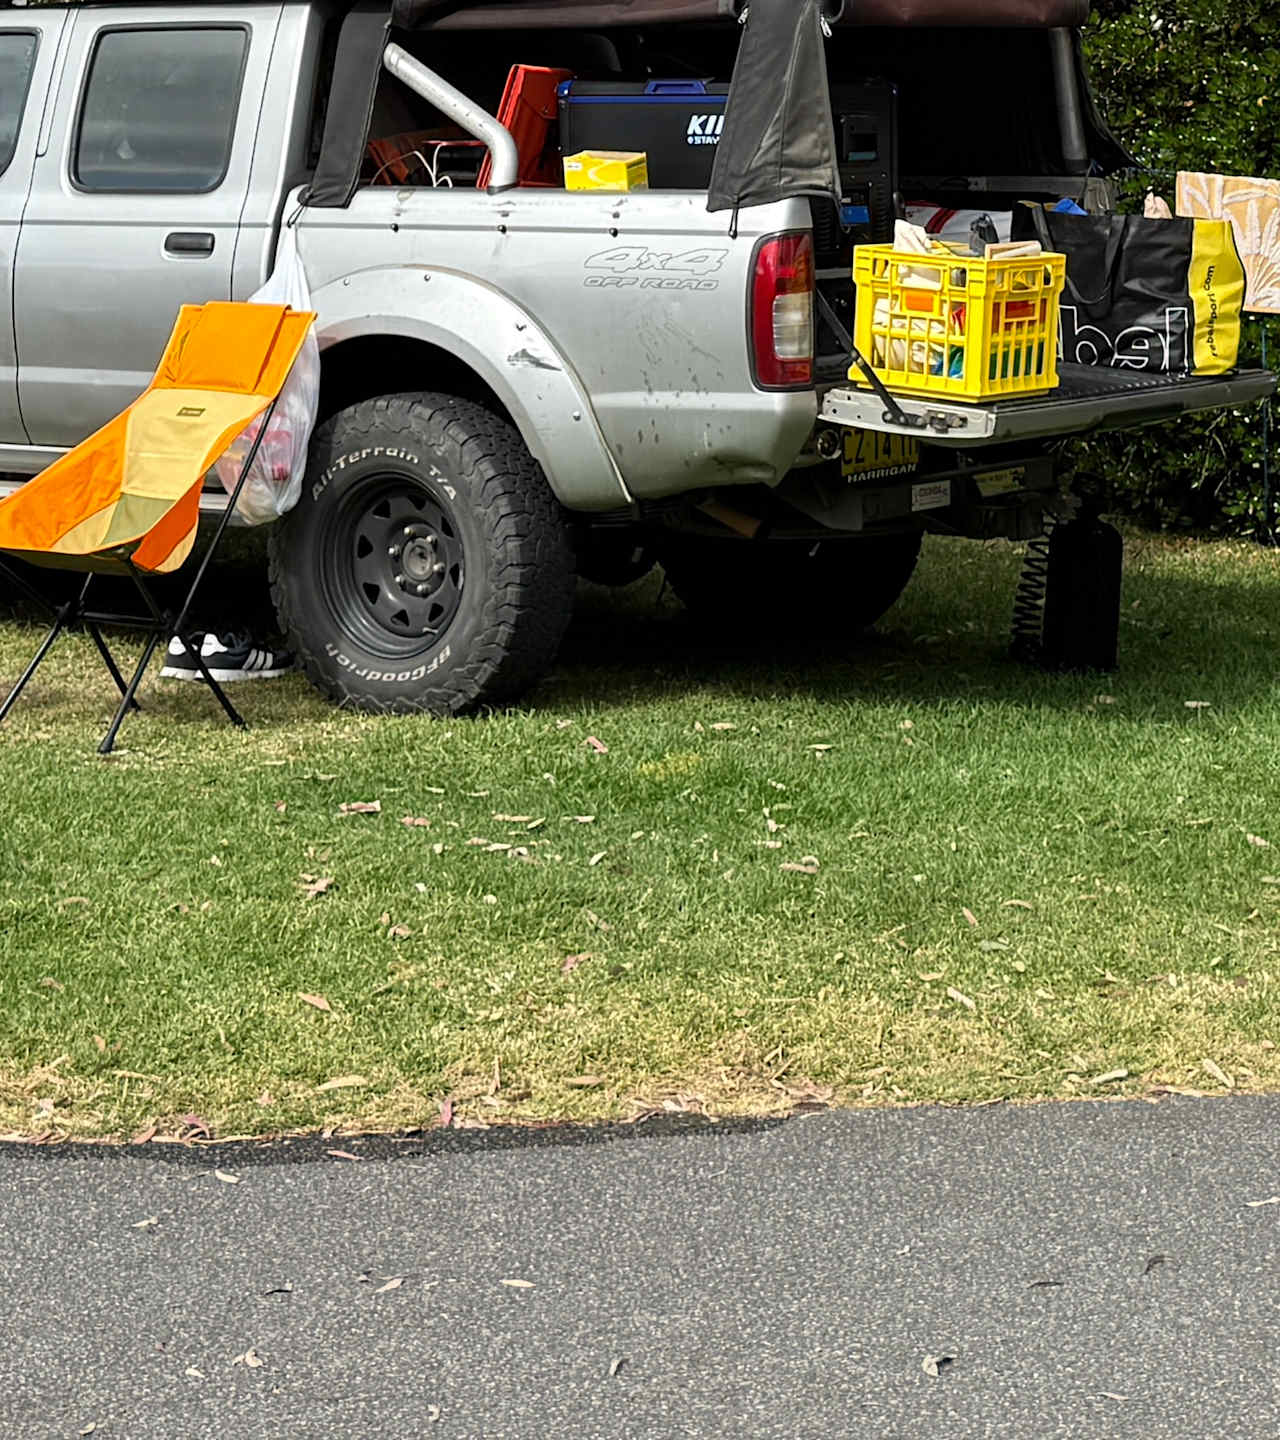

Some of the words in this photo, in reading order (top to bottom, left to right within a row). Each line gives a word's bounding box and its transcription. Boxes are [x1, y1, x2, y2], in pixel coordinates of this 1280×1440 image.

[583, 276, 639, 288] OFF
[640, 277, 719, 291] ROAD
[312, 446, 419, 502] All-Terrain
[428, 464, 457, 501] T/A
[325, 645, 452, 682] BFGoodrich
